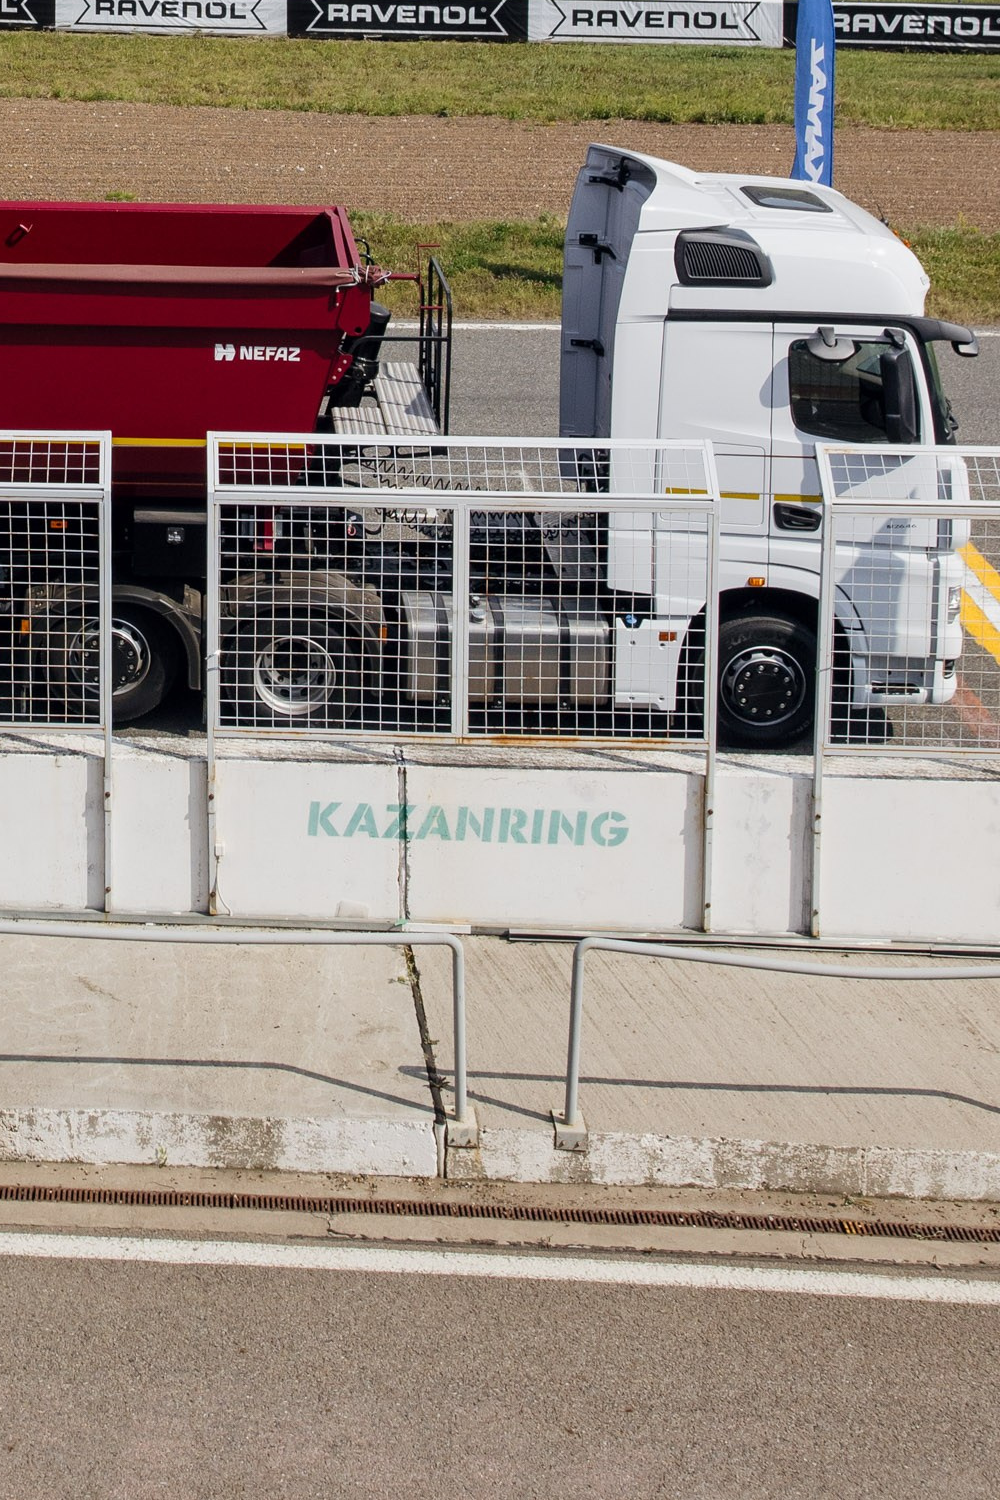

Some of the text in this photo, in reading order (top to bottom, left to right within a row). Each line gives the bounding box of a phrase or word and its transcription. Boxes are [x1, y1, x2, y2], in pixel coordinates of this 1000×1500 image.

[327, 3, 487, 25] RAVENOL
[572, 9, 738, 30] RAVENOL
[240, 346, 300, 362] NEFAZ
[307, 801, 629, 847] KAZANRING
